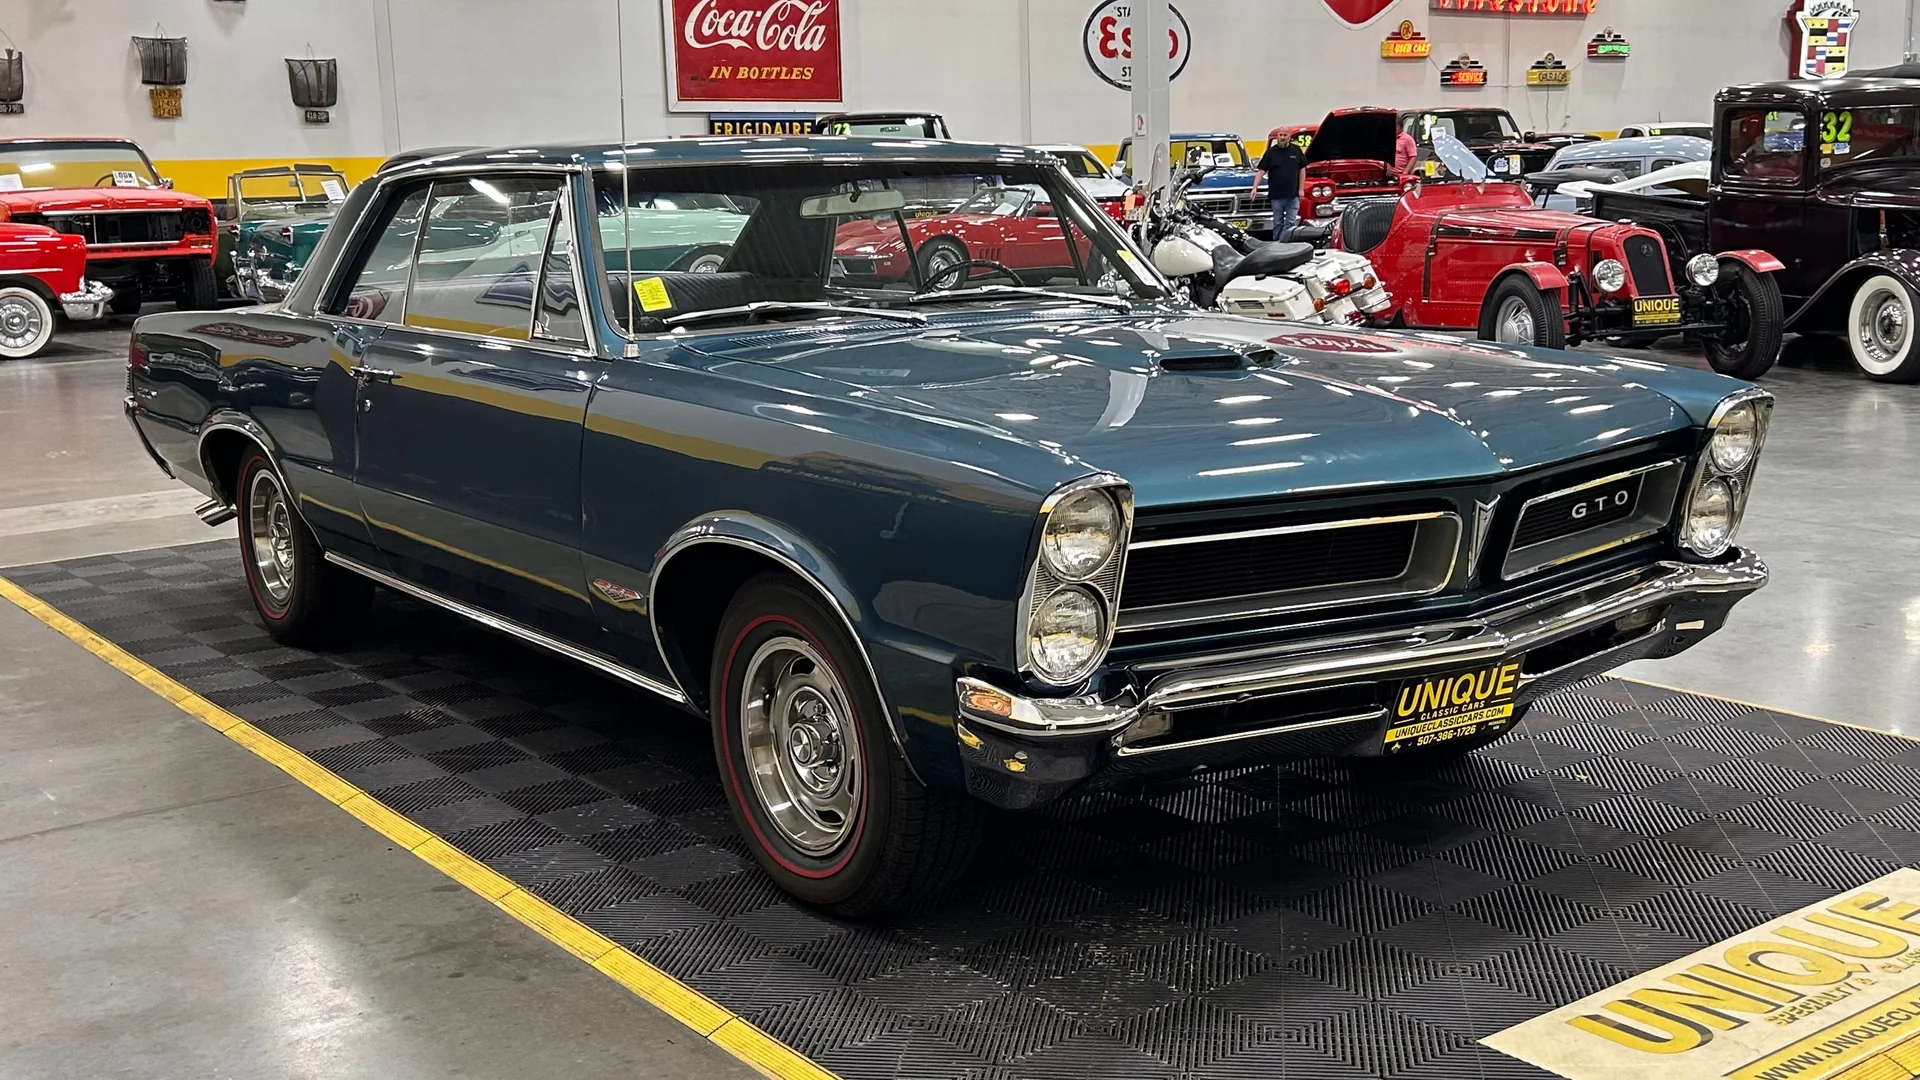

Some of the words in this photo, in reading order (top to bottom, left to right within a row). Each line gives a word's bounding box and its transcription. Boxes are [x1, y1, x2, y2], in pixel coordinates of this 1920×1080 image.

[684, 0, 831, 52] Coca-Cola
[709, 66, 732, 79] IN
[736, 66, 815, 80] BOTTLES
[713, 121, 813, 135] FRIGIDAIRE
[1298, 134, 1312, 147] 58
[1822, 111, 1852, 143] 32
[1634, 298, 1680, 312] UNIQUE
[1571, 490, 1629, 519] GTO
[1398, 663, 1519, 717] UNIQUE
[1394, 706, 1505, 738] UNIQUECLASSICCARS.COM
[1420, 707, 1459, 721] CLASSIC
[1462, 700, 1485, 712] CARS
[1565, 891, 1920, 1054] UNIQUE
[1763, 981, 1862, 1026] SPECIALTY
